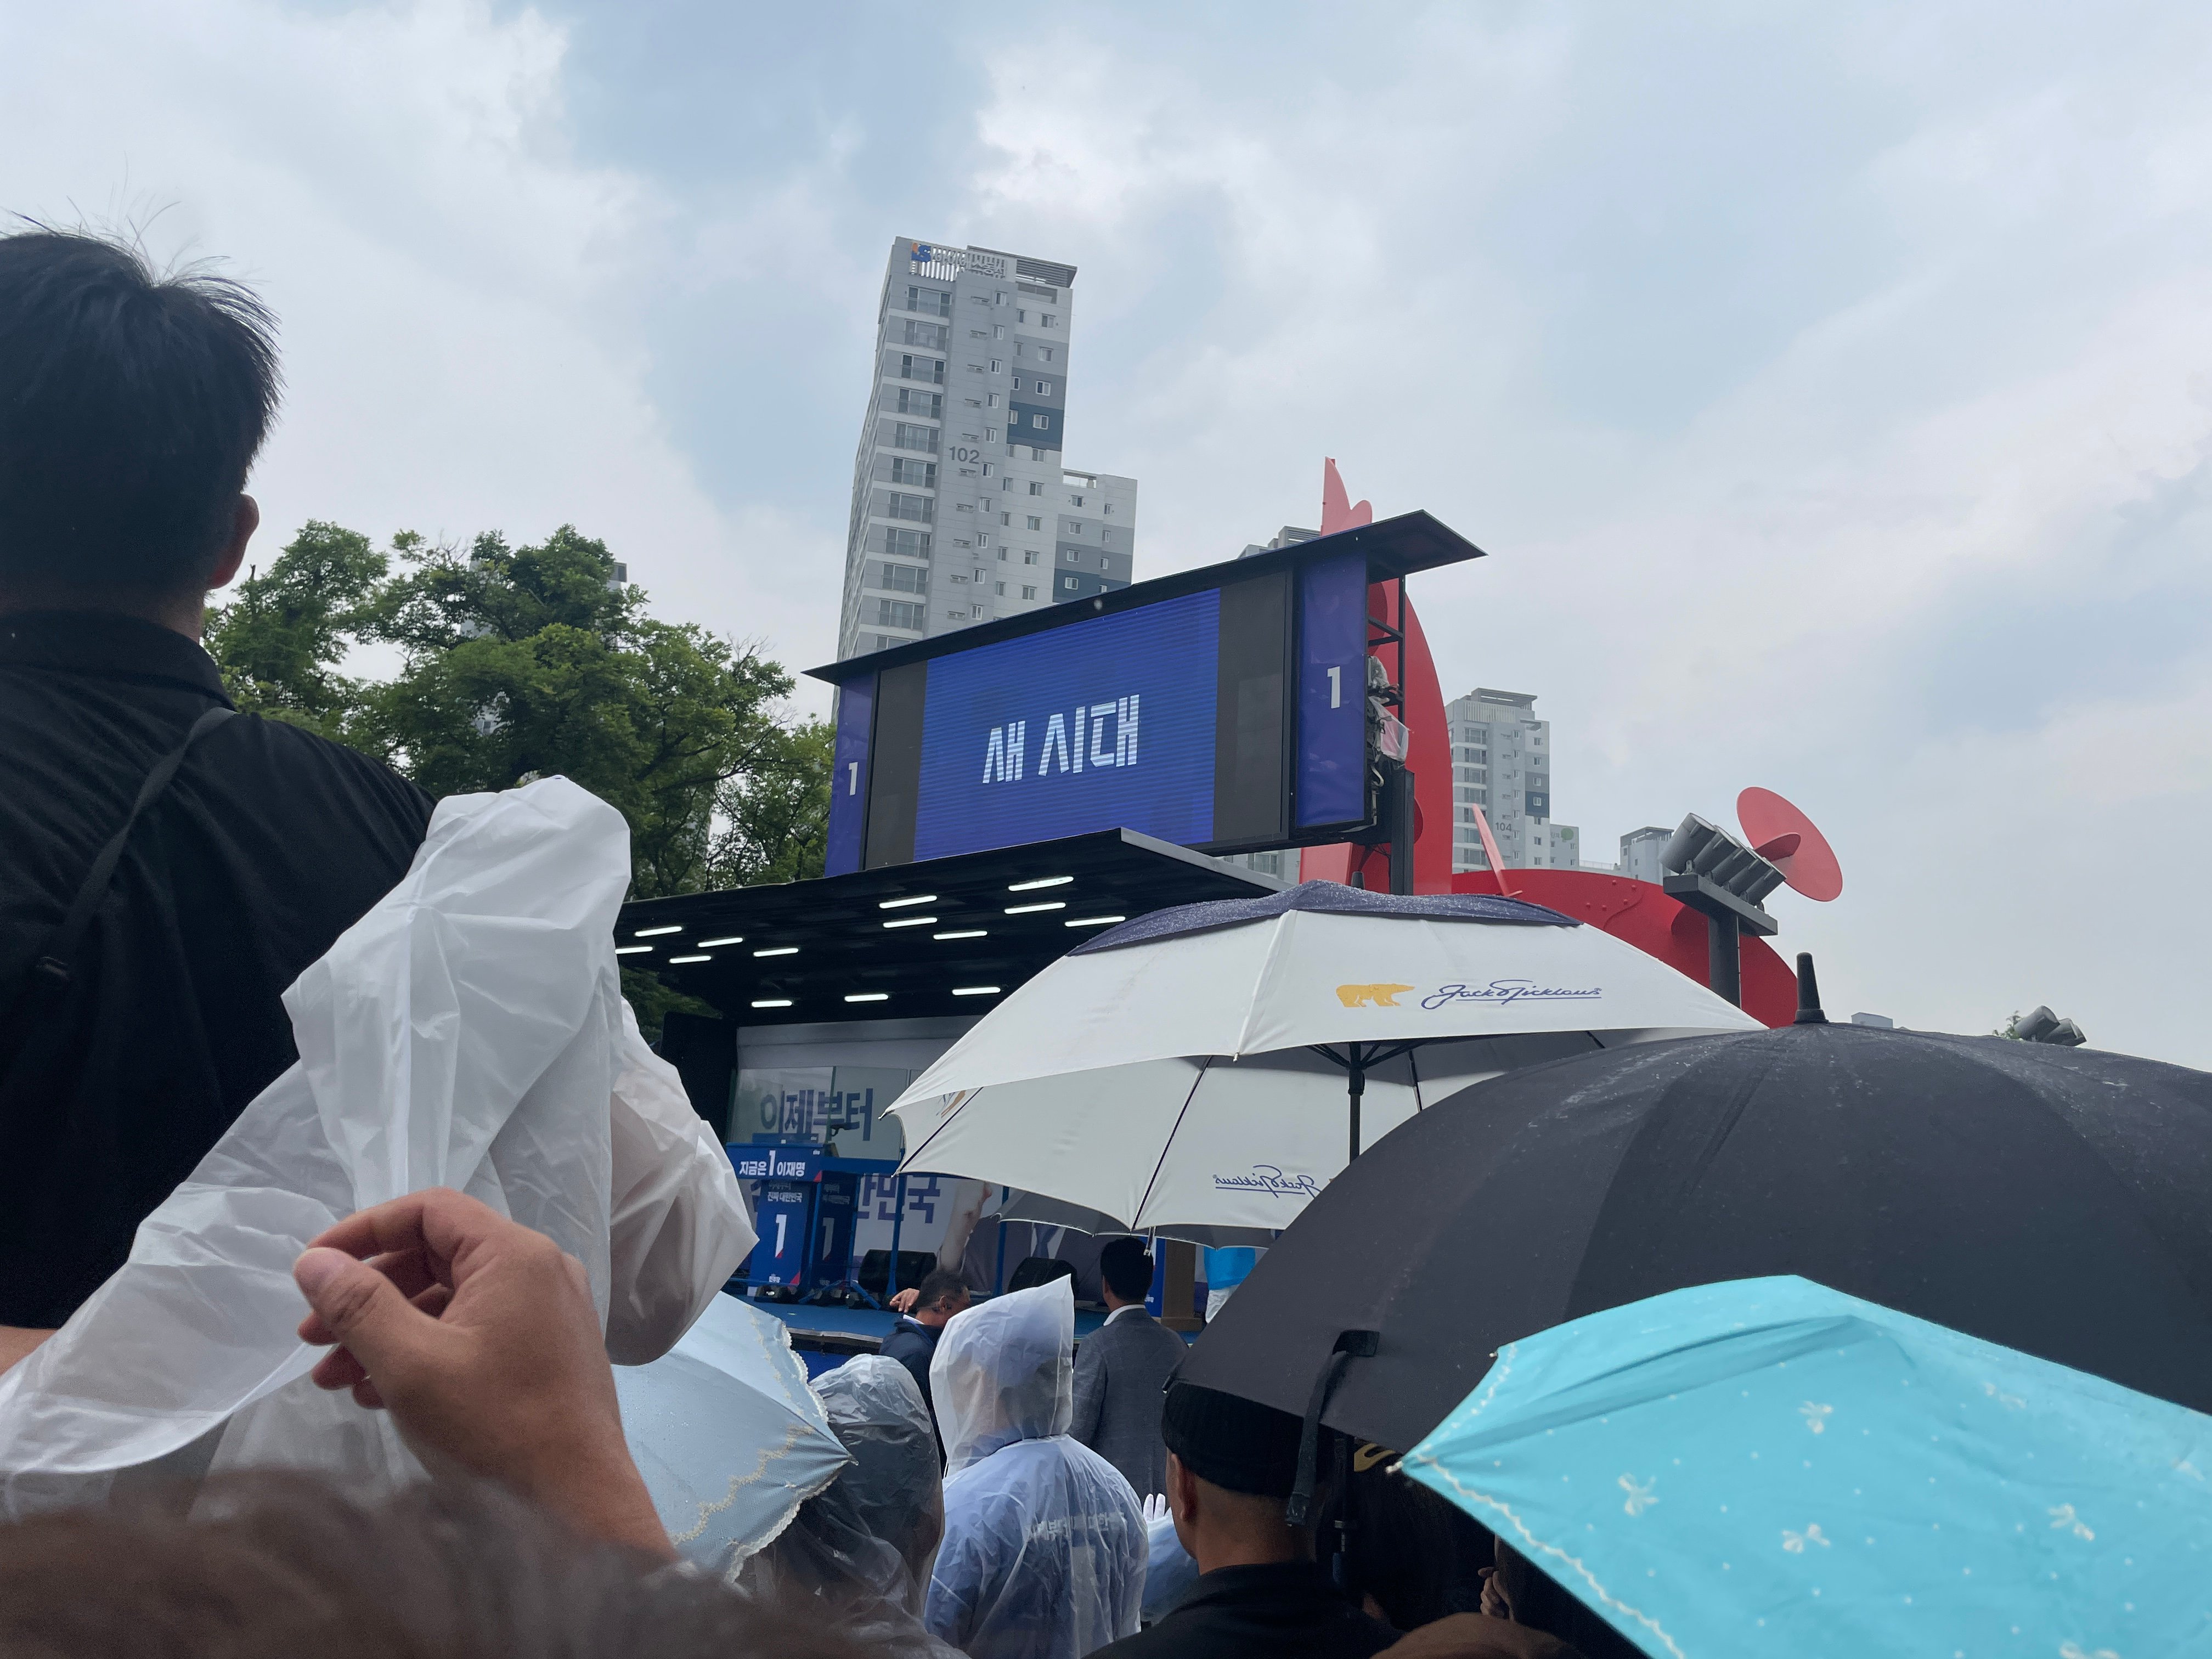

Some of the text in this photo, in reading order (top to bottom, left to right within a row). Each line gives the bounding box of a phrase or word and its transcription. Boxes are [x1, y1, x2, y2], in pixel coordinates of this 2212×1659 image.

[949, 445, 980, 464] 102
[1327, 665, 1341, 709] 1
[982, 694, 1139, 783] 새 시대
[848, 761, 858, 795] 1
[1496, 822, 1511, 832] 104
[760, 1088, 873, 1141] 이제부터
[739, 1150, 805, 1177] 지금은 1 이재명
[775, 1214, 787, 1258] 1
